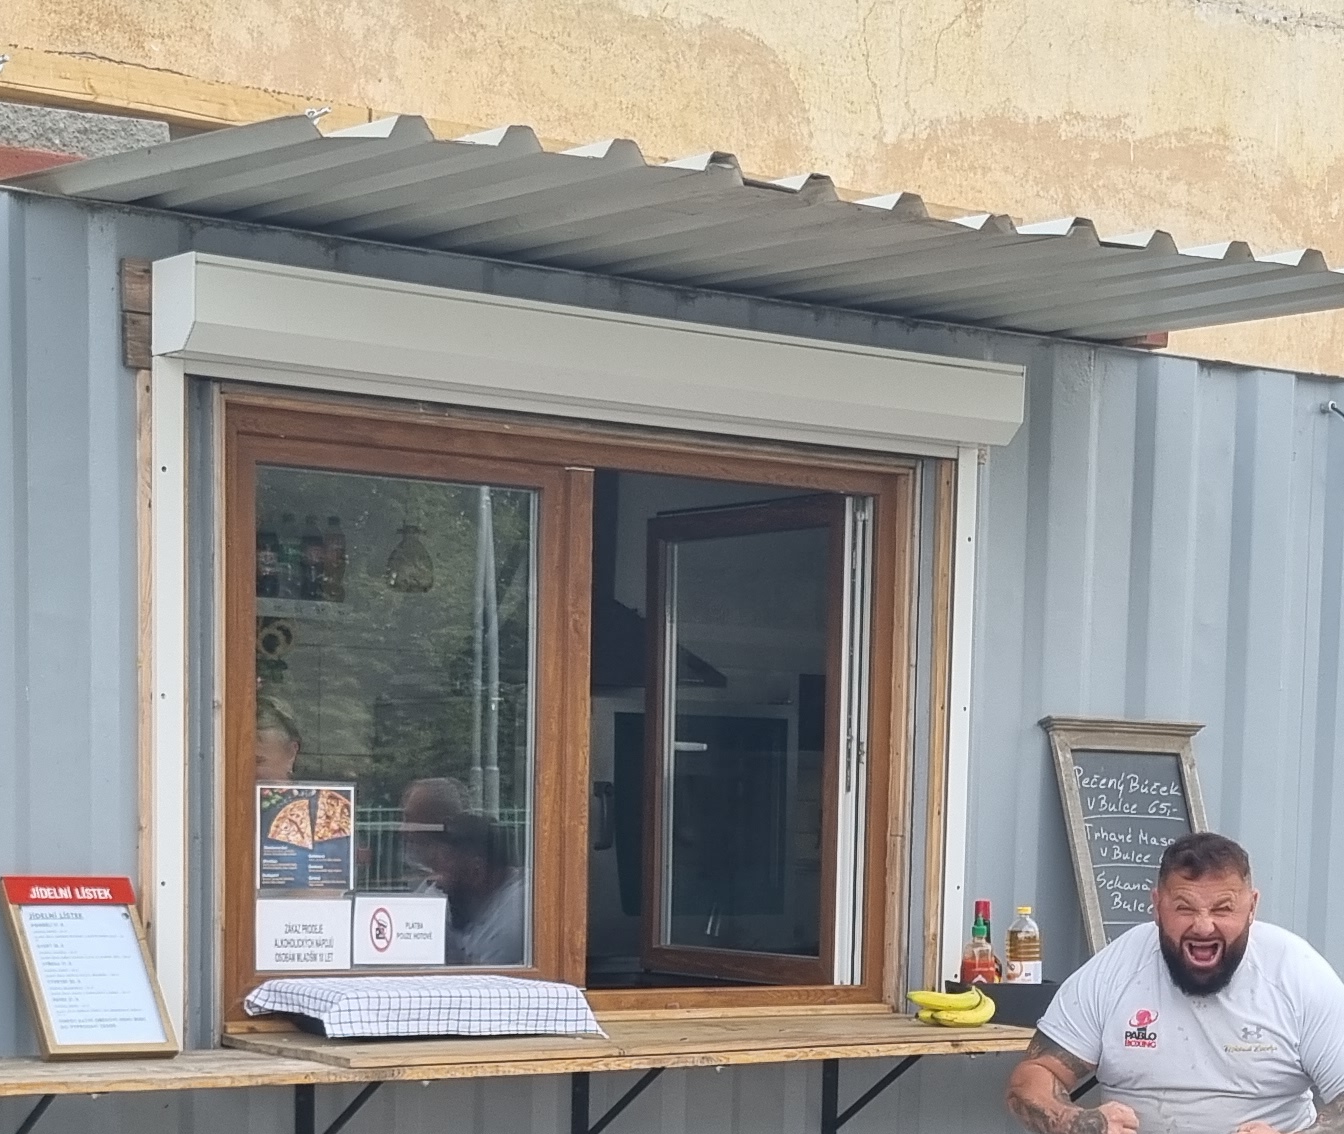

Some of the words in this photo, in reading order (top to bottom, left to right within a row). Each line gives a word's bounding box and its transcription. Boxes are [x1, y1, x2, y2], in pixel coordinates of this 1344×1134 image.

[1073, 766, 1125, 798] Pečený
[1098, 794, 1138, 814] Bulce
[1084, 823, 1132, 843] Trhané
[1111, 845, 1151, 863] Bulce
[29, 885, 73, 899] JÍDELNÍ
[74, 886, 113, 900] LÍSTEK
[1124, 1040, 1157, 1048] BOXING
[1125, 1030, 1157, 1041] PABLO
